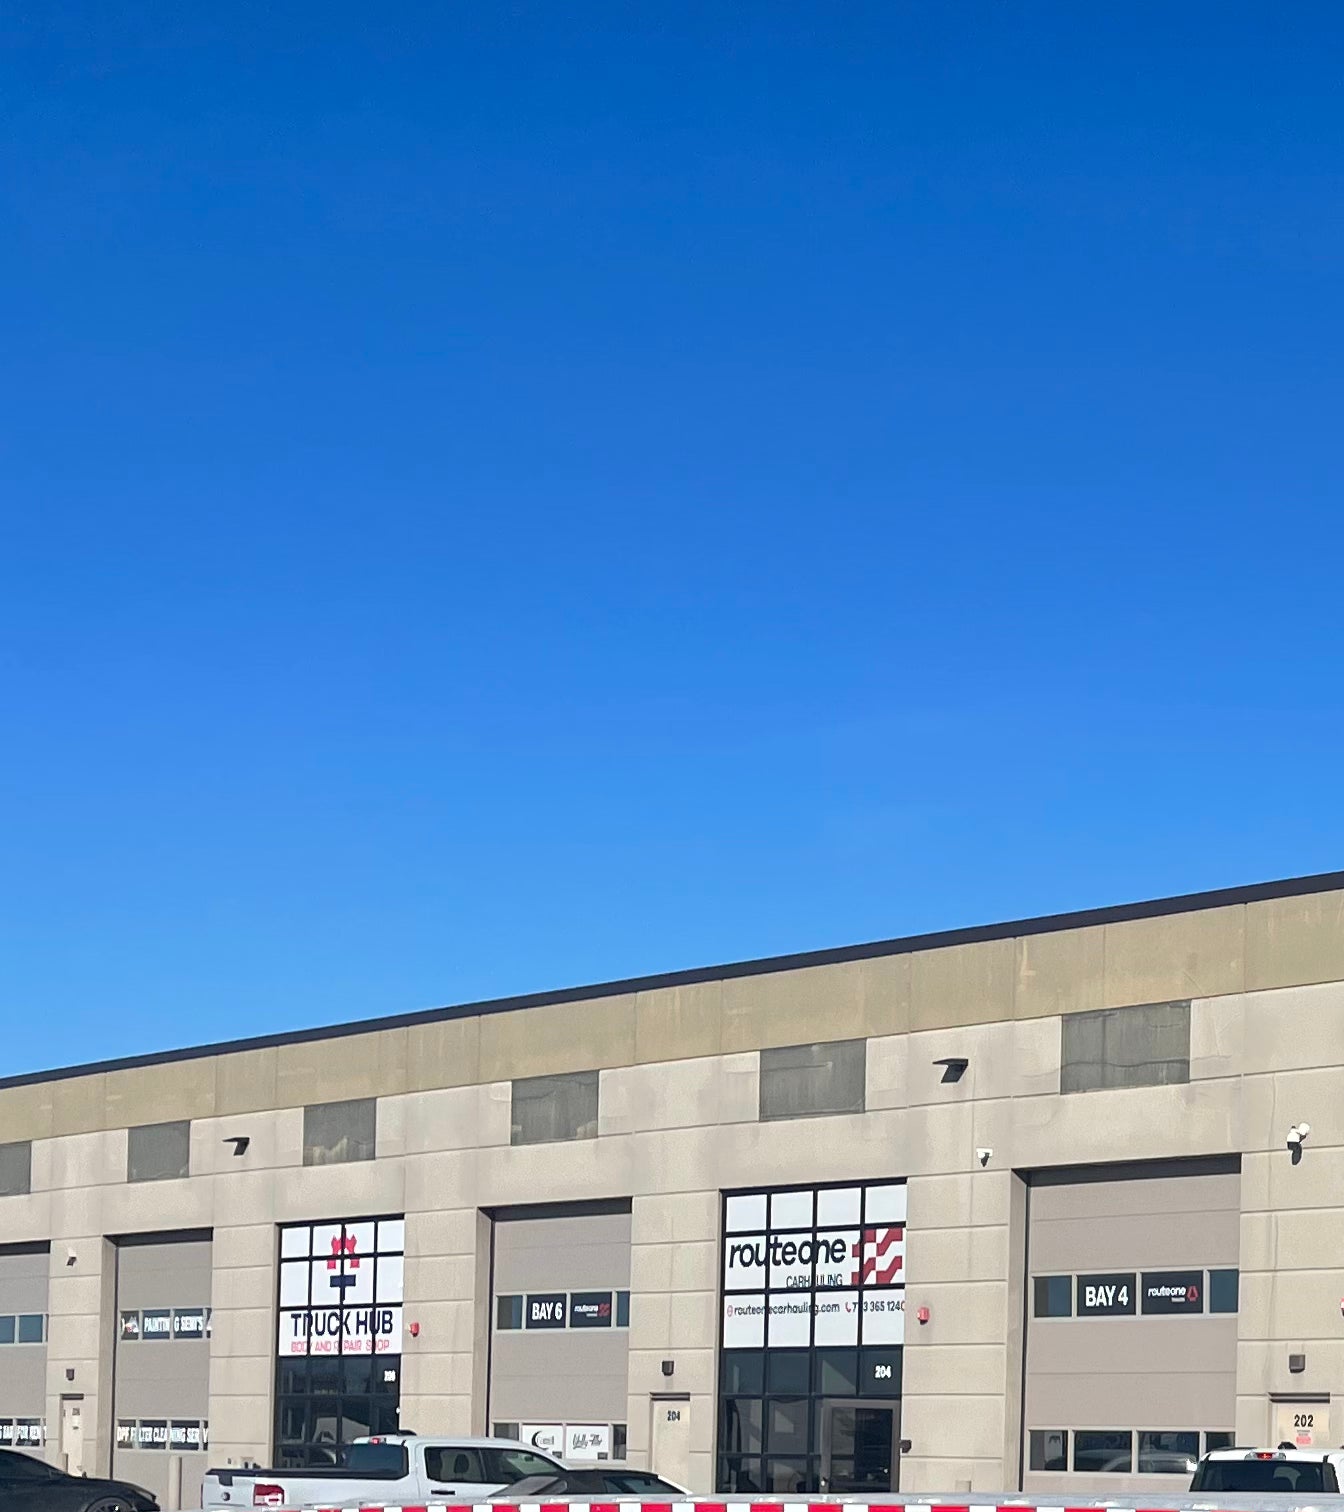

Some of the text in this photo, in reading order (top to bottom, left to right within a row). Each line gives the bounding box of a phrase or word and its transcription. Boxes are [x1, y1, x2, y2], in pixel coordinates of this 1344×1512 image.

[729, 1235, 846, 1268] routeone
[786, 1273, 843, 1288] CARHULING
[1085, 1285, 1128, 1307] BAY 4
[532, 1302, 563, 1320] BAY 6
[852, 1301, 868, 1313] 73
[870, 1301, 885, 1312] 365
[291, 1310, 393, 1337] TRUCK HUB
[291, 1342, 312, 1353] BOD
[334, 1340, 361, 1352] RPAIR
[366, 1339, 389, 1351] SOP
[875, 1365, 891, 1378] 204
[1294, 1414, 1314, 1427] 202
